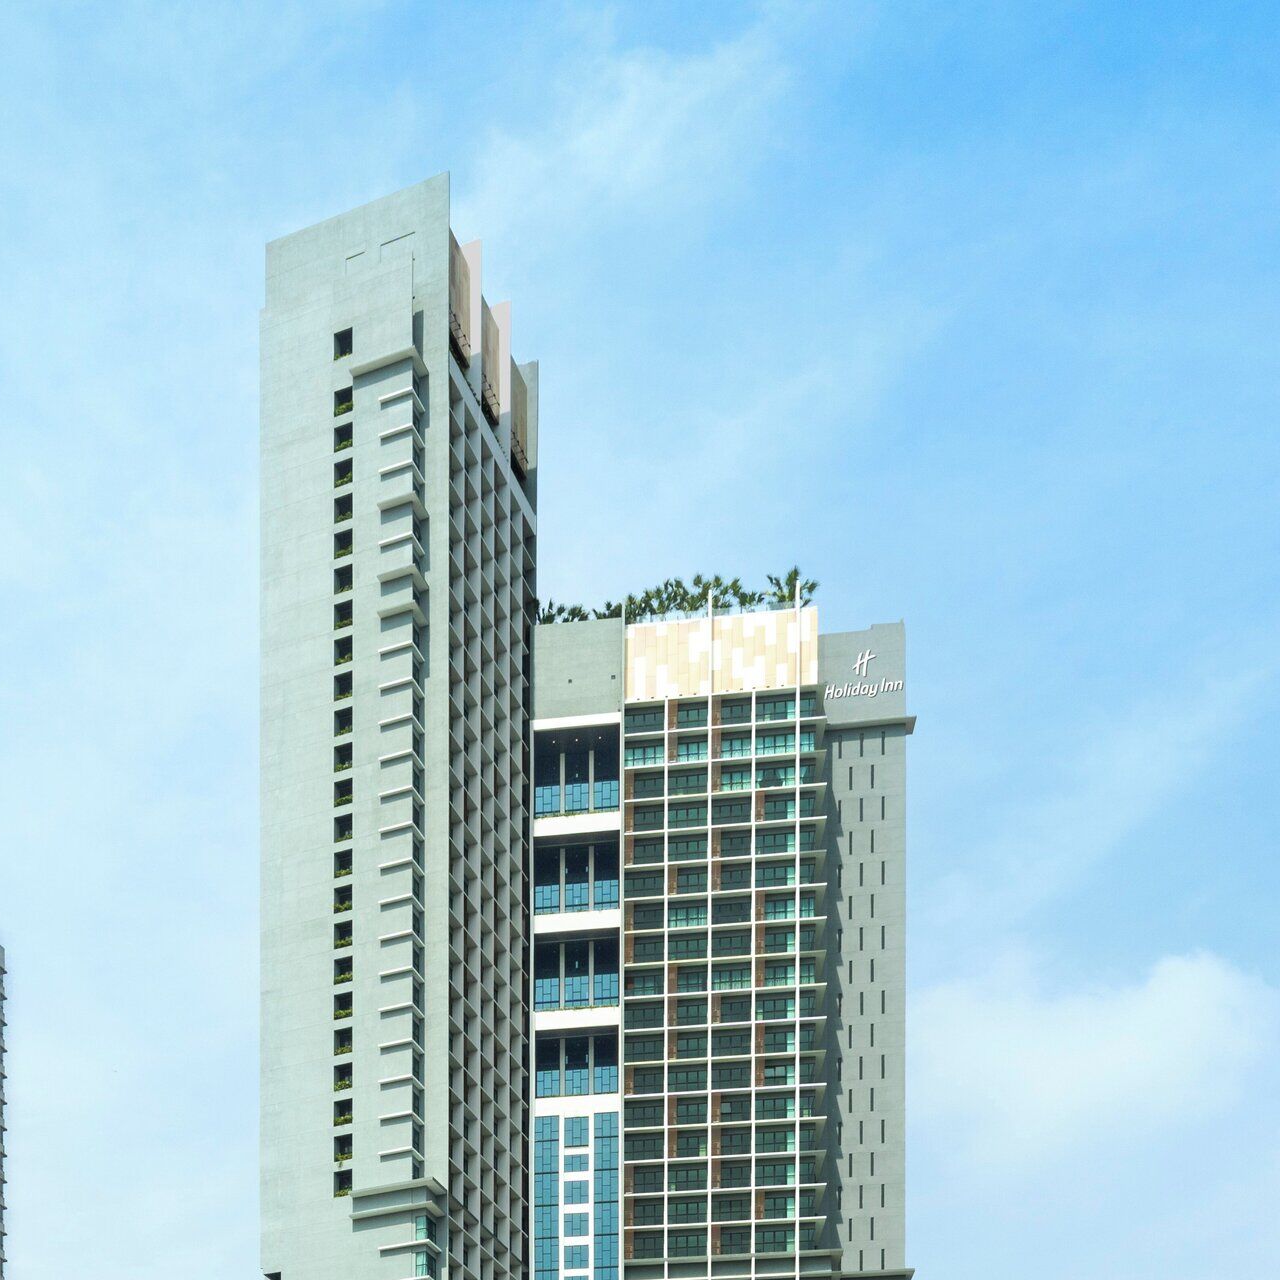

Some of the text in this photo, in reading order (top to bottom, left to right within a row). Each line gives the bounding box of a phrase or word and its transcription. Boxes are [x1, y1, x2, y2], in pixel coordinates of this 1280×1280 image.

[851, 649, 877, 677] H
[824, 677, 904, 700] Holiday Inn
